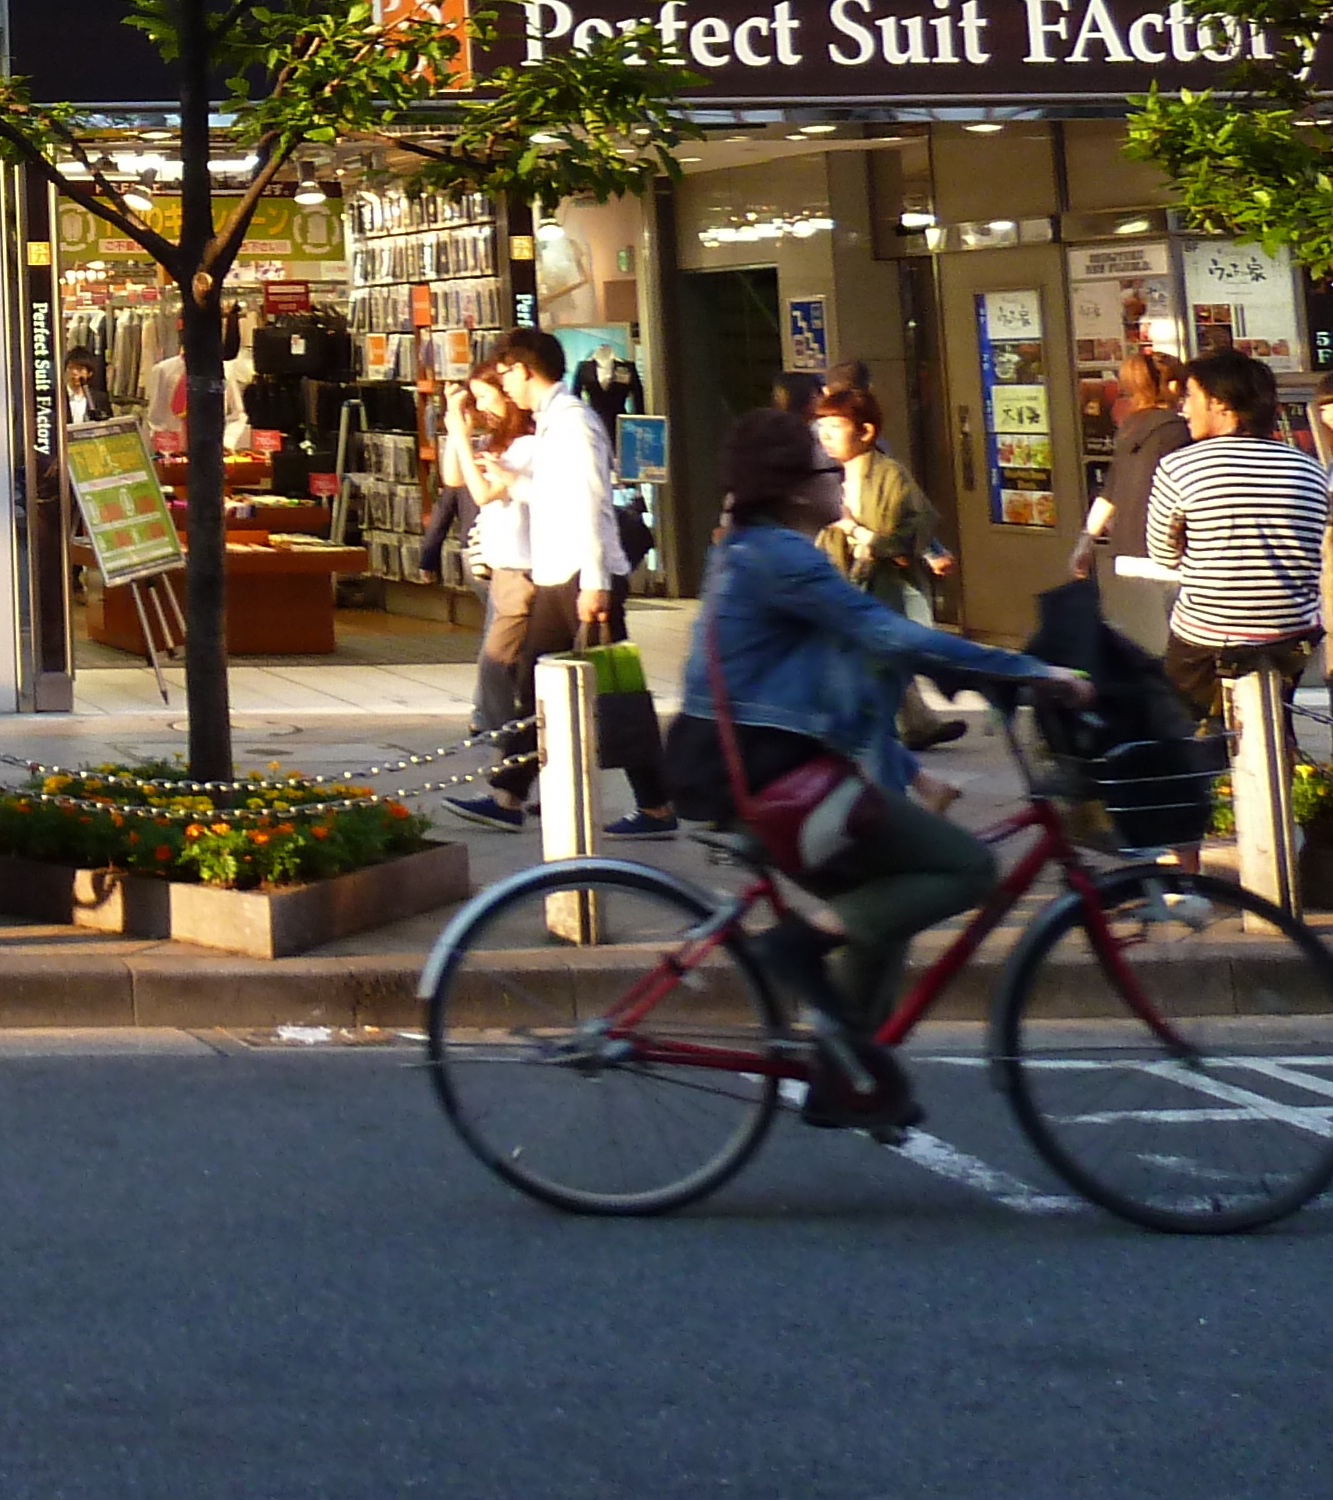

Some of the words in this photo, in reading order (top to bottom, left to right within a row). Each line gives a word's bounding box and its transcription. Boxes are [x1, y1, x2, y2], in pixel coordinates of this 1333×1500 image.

[516, 293, 533, 326] Perf
[32, 302, 50, 357] Perfect
[35, 359, 52, 392] Suit
